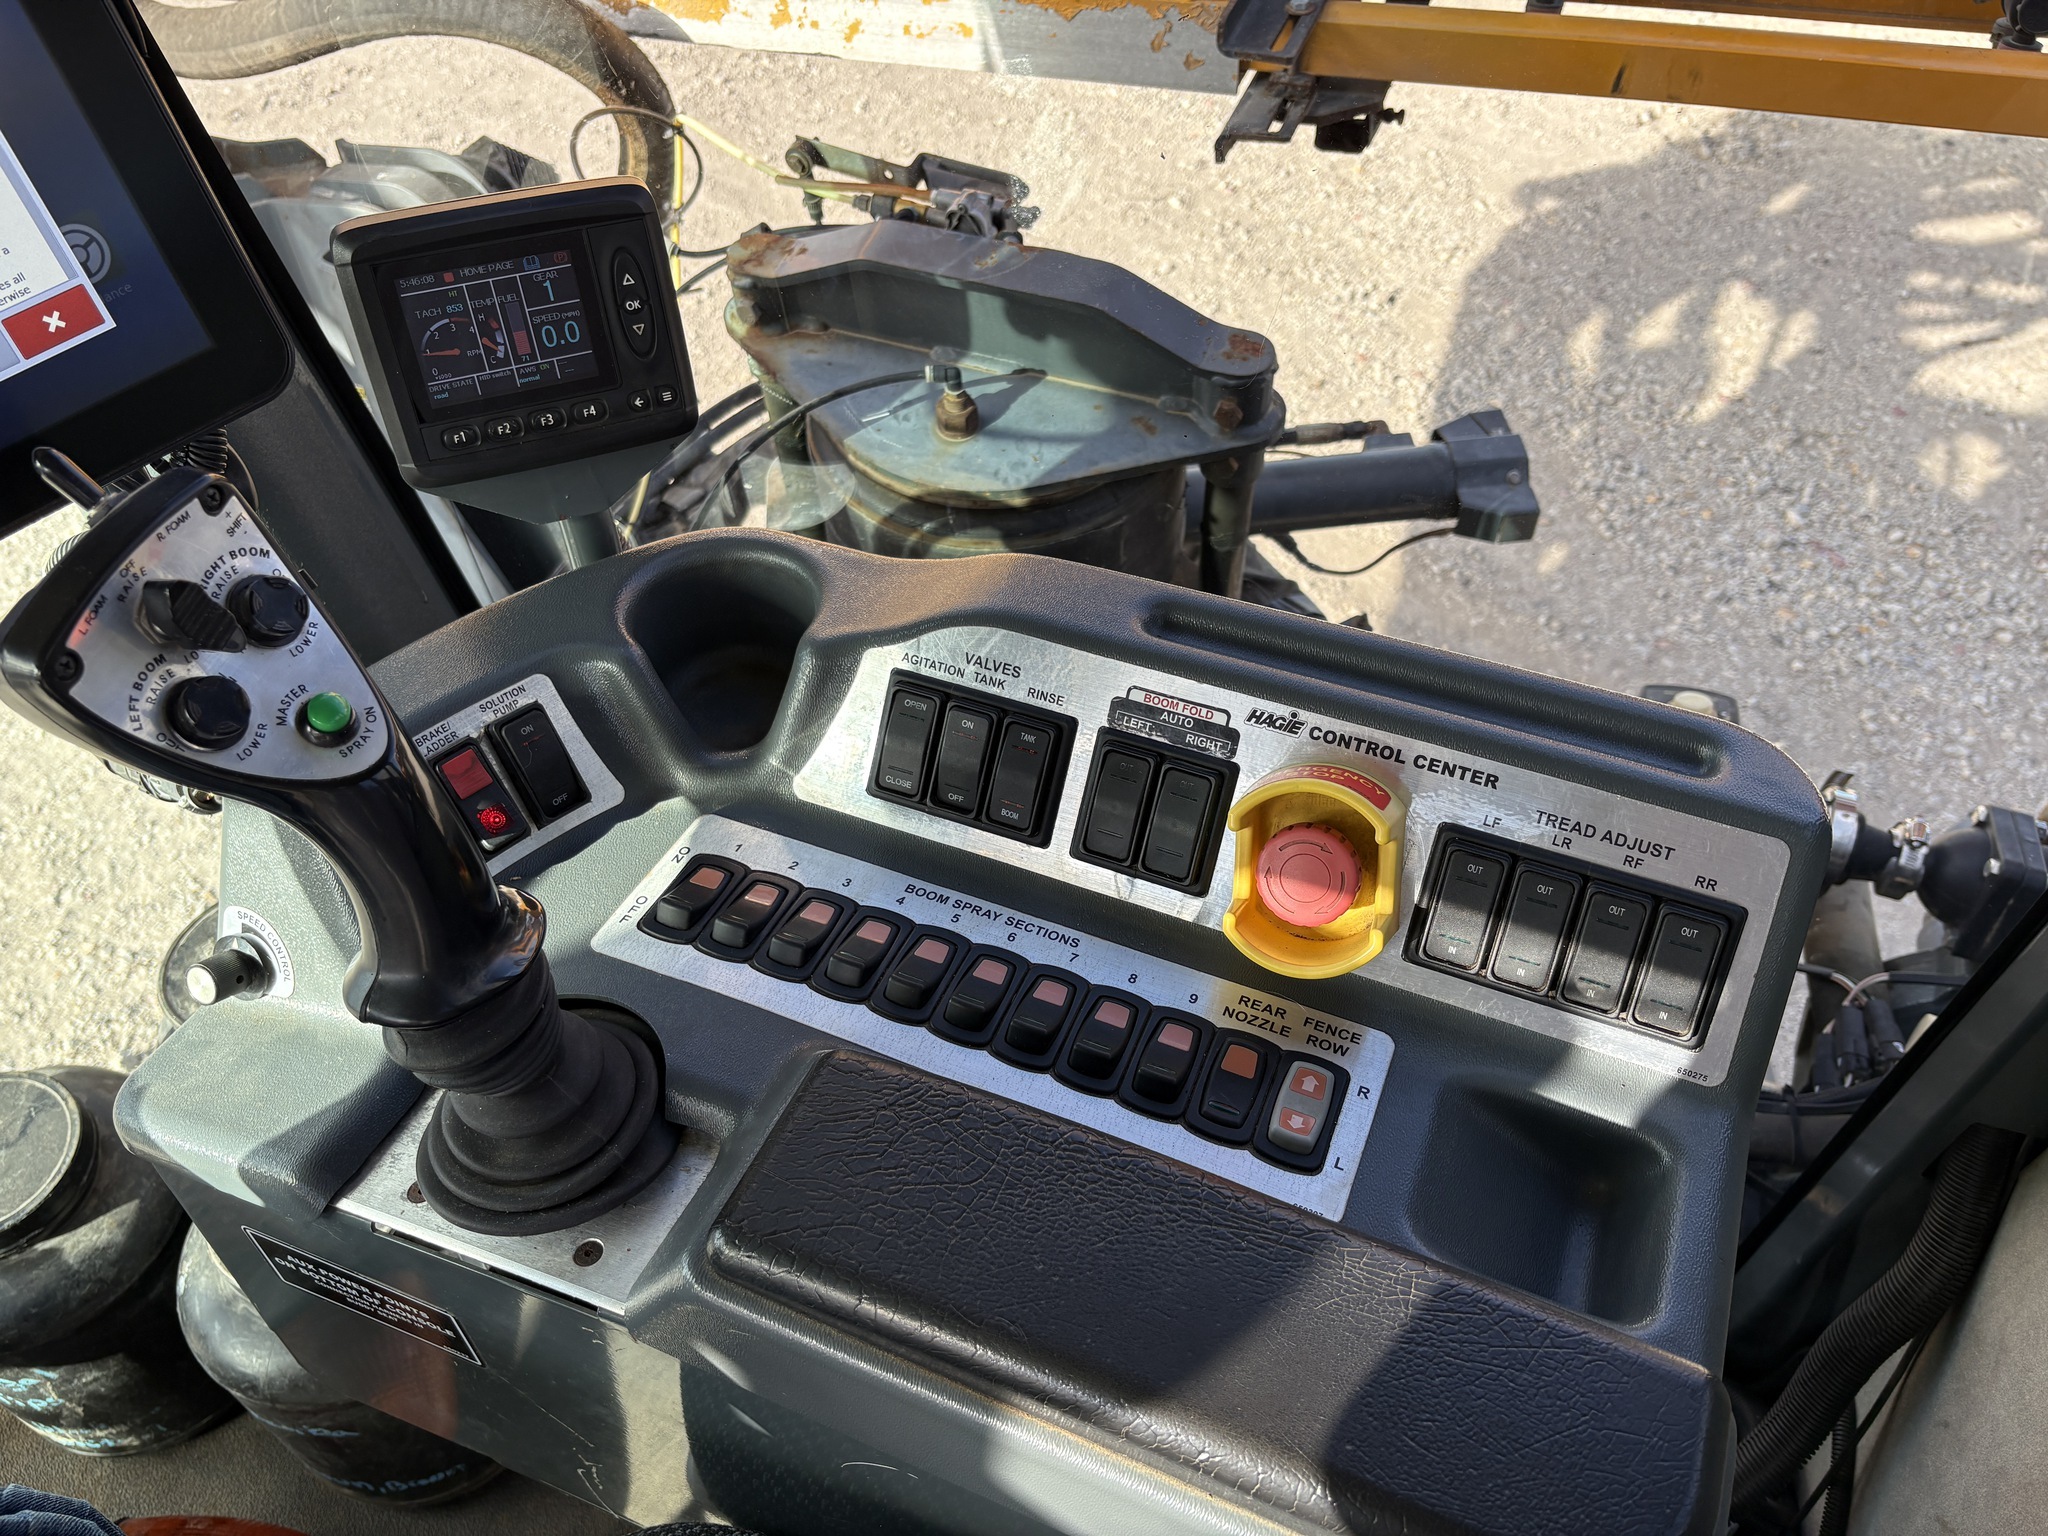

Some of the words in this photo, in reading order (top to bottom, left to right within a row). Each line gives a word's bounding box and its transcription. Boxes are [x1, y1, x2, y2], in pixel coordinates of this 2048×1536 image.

[13, 272, 26, 282] all
[400, 275, 435, 288] 5:46:08
[460, 266, 487, 277] HOME
[490, 261, 514, 273] PAGE
[533, 271, 559, 282] GEAR
[497, 293, 519, 305] FUEL
[543, 280, 554, 301] 1
[414, 307, 442, 319] TACH
[446, 303, 464, 314] 853
[470, 298, 494, 309] TEMP
[626, 300, 641, 311] OK
[450, 323, 456, 332] 3
[532, 313, 560, 325] SPEED
[433, 332, 440, 340] 2
[469, 326, 475, 334] 4
[541, 320, 581, 348] 0.0
[467, 349, 482, 357] RPM
[520, 366, 537, 375] AWS
[429, 384, 451, 393] DRIVE
[452, 379, 474, 388] STATE
[541, 414, 554, 426] F3
[583, 405, 596, 418] F4
[497, 423, 511, 435] F2
[454, 432, 466, 444] F1
[165, 510, 192, 536] FOAM
[226, 512, 248, 538] SHIFT
[229, 546, 271, 565] BOOM
[119, 558, 137, 579] OFF
[118, 566, 148, 603] RAISE
[211, 564, 240, 600] RAISE
[86, 595, 109, 626] FOAM
[289, 621, 319, 658] LOWER
[133, 653, 167, 692] BOOM
[901, 652, 966, 679] AGITATION
[965, 652, 1022, 679] VALVES
[146, 668, 176, 705] RAISE
[974, 671, 1006, 691] TANK
[276, 683, 310, 726] MASTER
[479, 684, 527, 713] SOLUTION
[904, 699, 927, 711] OPEN
[1027, 687, 1066, 707] RINSE
[128, 694, 145, 731] LEFT
[493, 699, 520, 719] PUMP
[1143, 693, 1180, 712] BOOM
[1182, 703, 1214, 721] FOLD
[961, 719, 974, 730] ON
[1123, 716, 1152, 732] LEFT
[1160, 711, 1194, 728] AUTO
[339, 722, 376, 759] SPRAY
[363, 705, 378, 724] ON
[415, 721, 452, 748] BRAKE/
[520, 724, 534, 735] ON
[1020, 731, 1037, 744] TANK
[156, 732, 186, 752] OUT
[236, 722, 269, 762] LOWER
[424, 731, 460, 758] ADDER
[1185, 733, 1223, 752] RIGHT
[1309, 726, 1405, 764] CONTROL
[1413, 755, 1500, 790] CENTER
[885, 775, 912, 789] CLOSE
[552, 793, 568, 806] OFF
[948, 792, 964, 803] OFF
[1001, 808, 1019, 820] BOOM
[1482, 814, 1503, 829] LF
[1535, 810, 1597, 838] TREAD
[1599, 831, 1676, 861] ADJUST
[1552, 834, 1572, 850] LR
[671, 846, 691, 864] ON
[1622, 854, 1645, 870] RF
[1467, 864, 1484, 876] OUT
[1536, 884, 1554, 897] OUT
[1694, 875, 1718, 892] RR
[619, 895, 648, 924] OFF
[904, 883, 950, 905] BOOM
[952, 899, 1004, 922] SPRAY
[1004, 916, 1081, 948] SECTIONS
[1608, 905, 1626, 917] OUT
[734, 843, 743, 853] 1
[788, 861, 799, 870] 2
[842, 878, 852, 888] 3
[895, 896, 906, 906] 4
[950, 914, 961, 923] 5
[1007, 932, 1017, 942] 6
[1069, 953, 1079, 963] 7
[1128, 973, 1138, 984] 8
[1188, 993, 1199, 1005] 9
[1680, 926, 1699, 939] OUT
[237, 910, 267, 933] SPEED
[267, 931, 291, 982] CONTROL
[1448, 946, 1457, 955] IN
[1516, 968, 1525, 978] IN
[1586, 989, 1596, 998] IN
[1238, 995, 1287, 1020] REAR
[1658, 1011, 1668, 1021] IN
[1222, 1005, 1292, 1038] NOZZLE
[1303, 1016, 1362, 1045] FENCE
[1306, 1035, 1350, 1057] ROW
[1676, 1067, 1709, 1083] 650275
[1357, 1085, 1371, 1099] R
[1334, 1156, 1344, 1171] L
[287, 1255, 317, 1272] AUX
[318, 1268, 372, 1294] POWER
[373, 1291, 430, 1319] POINTS
[274, 1257, 297, 1270] ON
[298, 1267, 360, 1296] BOTTOM
[362, 1294, 381, 1305] OF
[385, 1303, 456, 1338] CONSOLE
